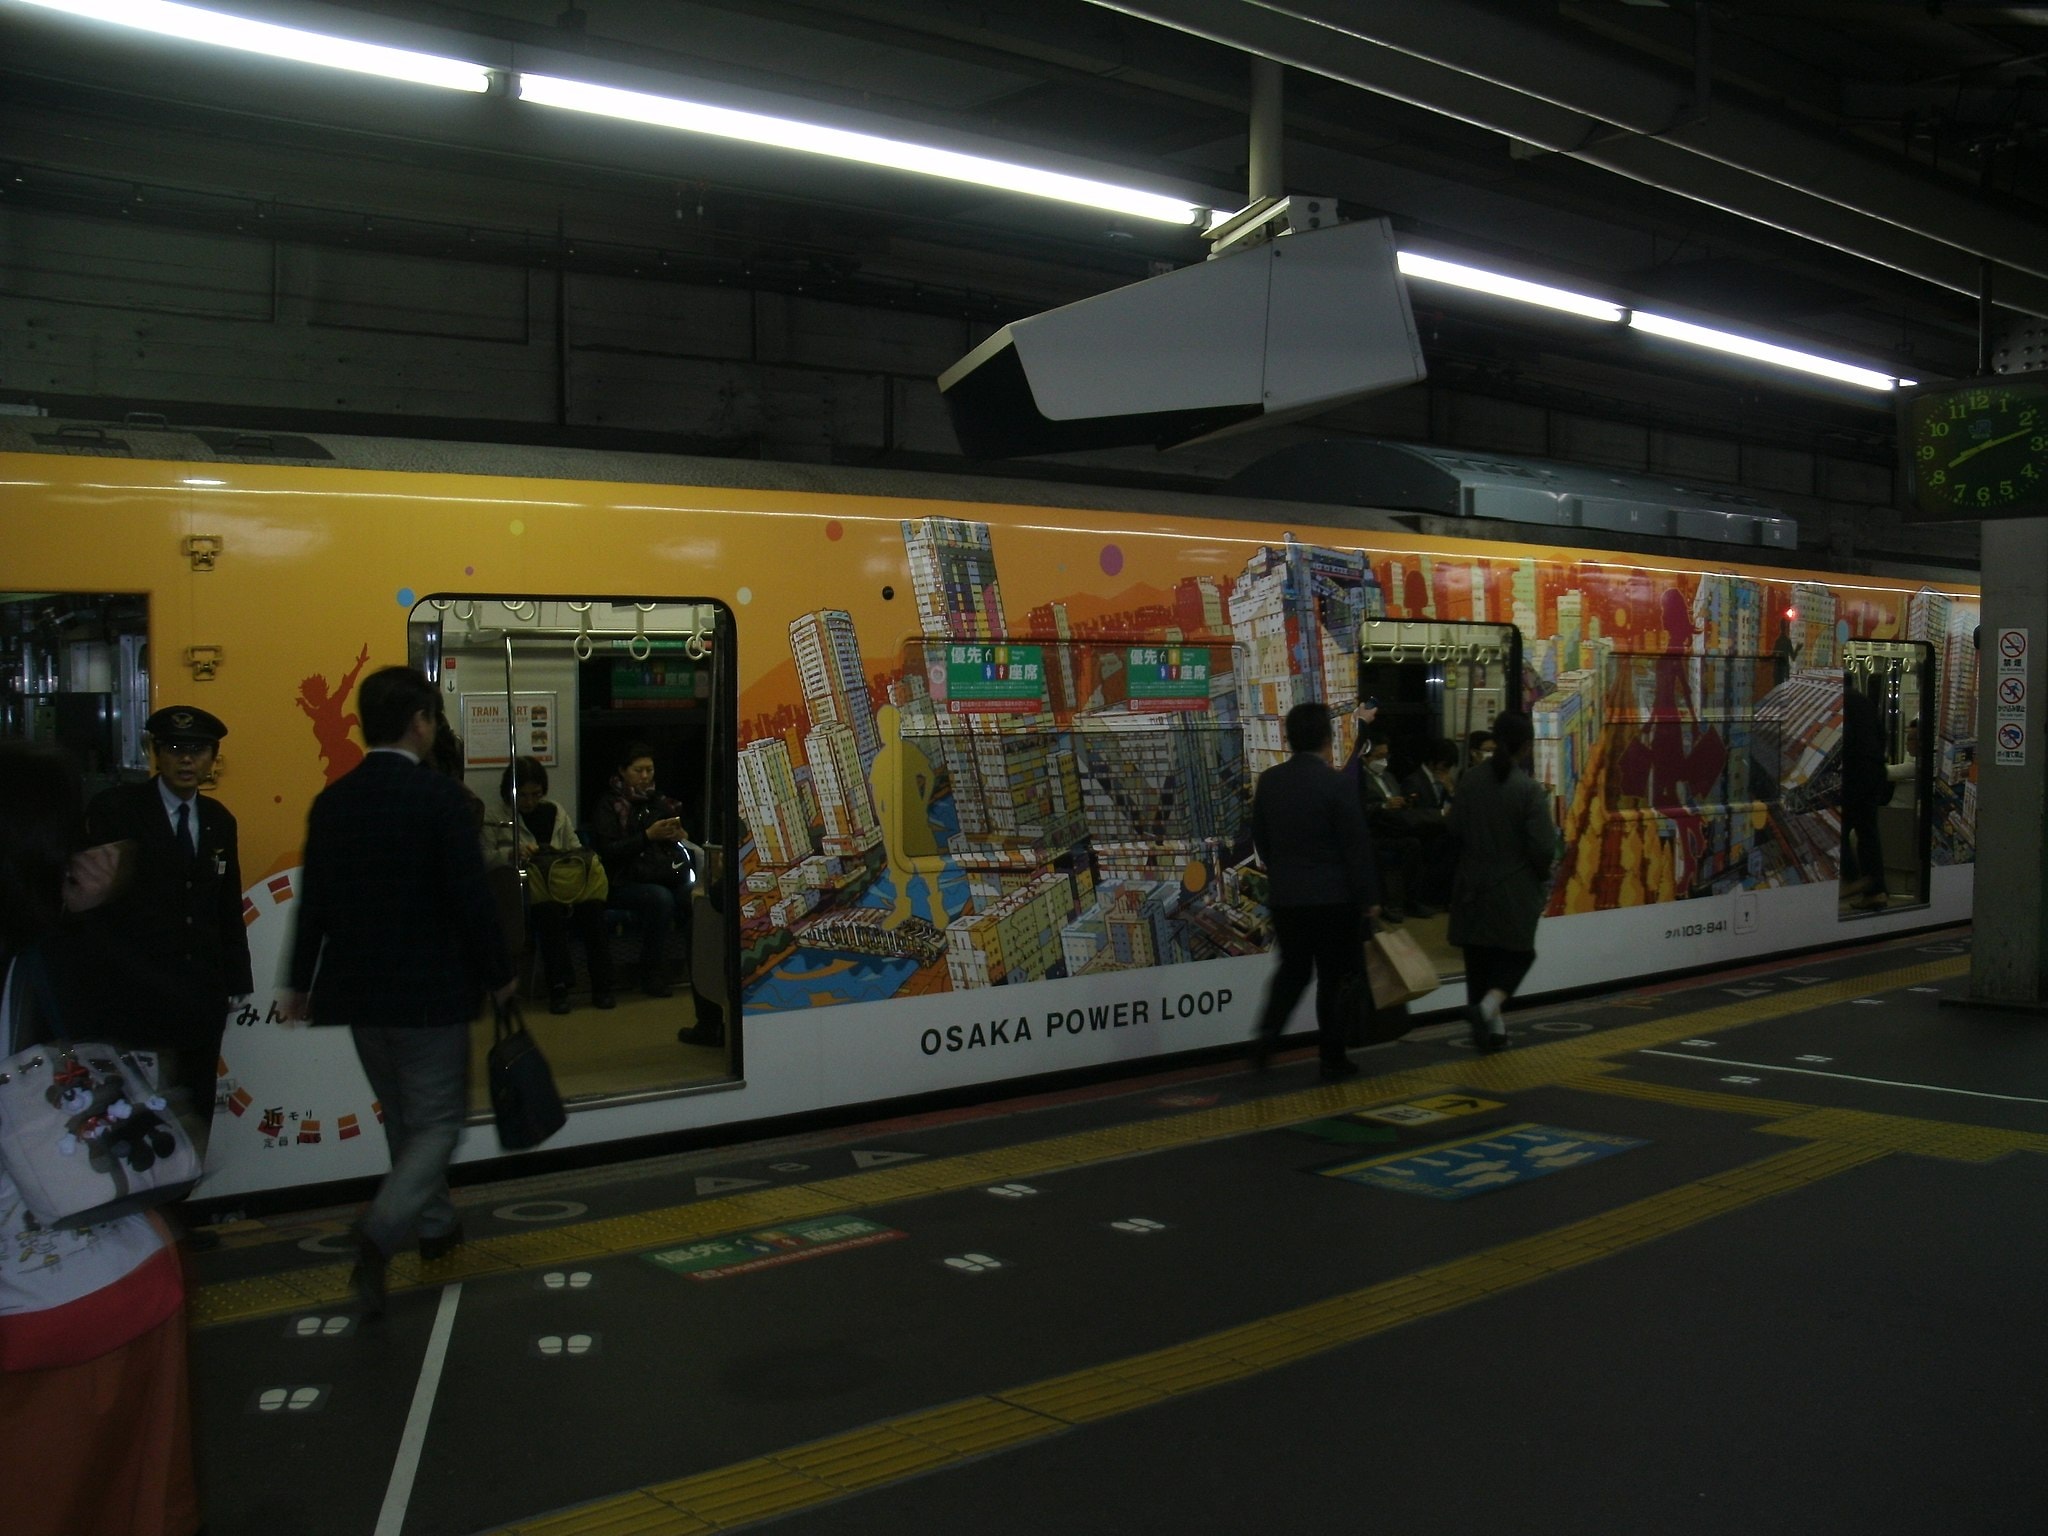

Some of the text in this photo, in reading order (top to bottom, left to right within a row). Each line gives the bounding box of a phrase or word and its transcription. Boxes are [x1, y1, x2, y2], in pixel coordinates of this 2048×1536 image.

[1968, 395, 1990, 410] 12
[2000, 398, 2008, 413] 1
[1950, 404, 1967, 419] 11
[2018, 411, 2033, 426] 2
[1930, 422, 1949, 437] 10
[2030, 436, 2044, 451] 3
[1921, 445, 1935, 460] 9
[1932, 469, 1946, 485] 8
[2020, 463, 2034, 478] 4
[1954, 483, 1967, 499] 7
[1976, 486, 1990, 502] 6
[2000, 480, 2013, 496] 5
[951, 646, 983, 664] 優先
[1130, 649, 1157, 665] 優先
[1009, 664, 1038, 680] 座席
[1180, 664, 1206, 680] 座席
[471, 705, 528, 717] TRAIN RT
[921, 988, 1233, 1055] OSAKA POWER LOOP
